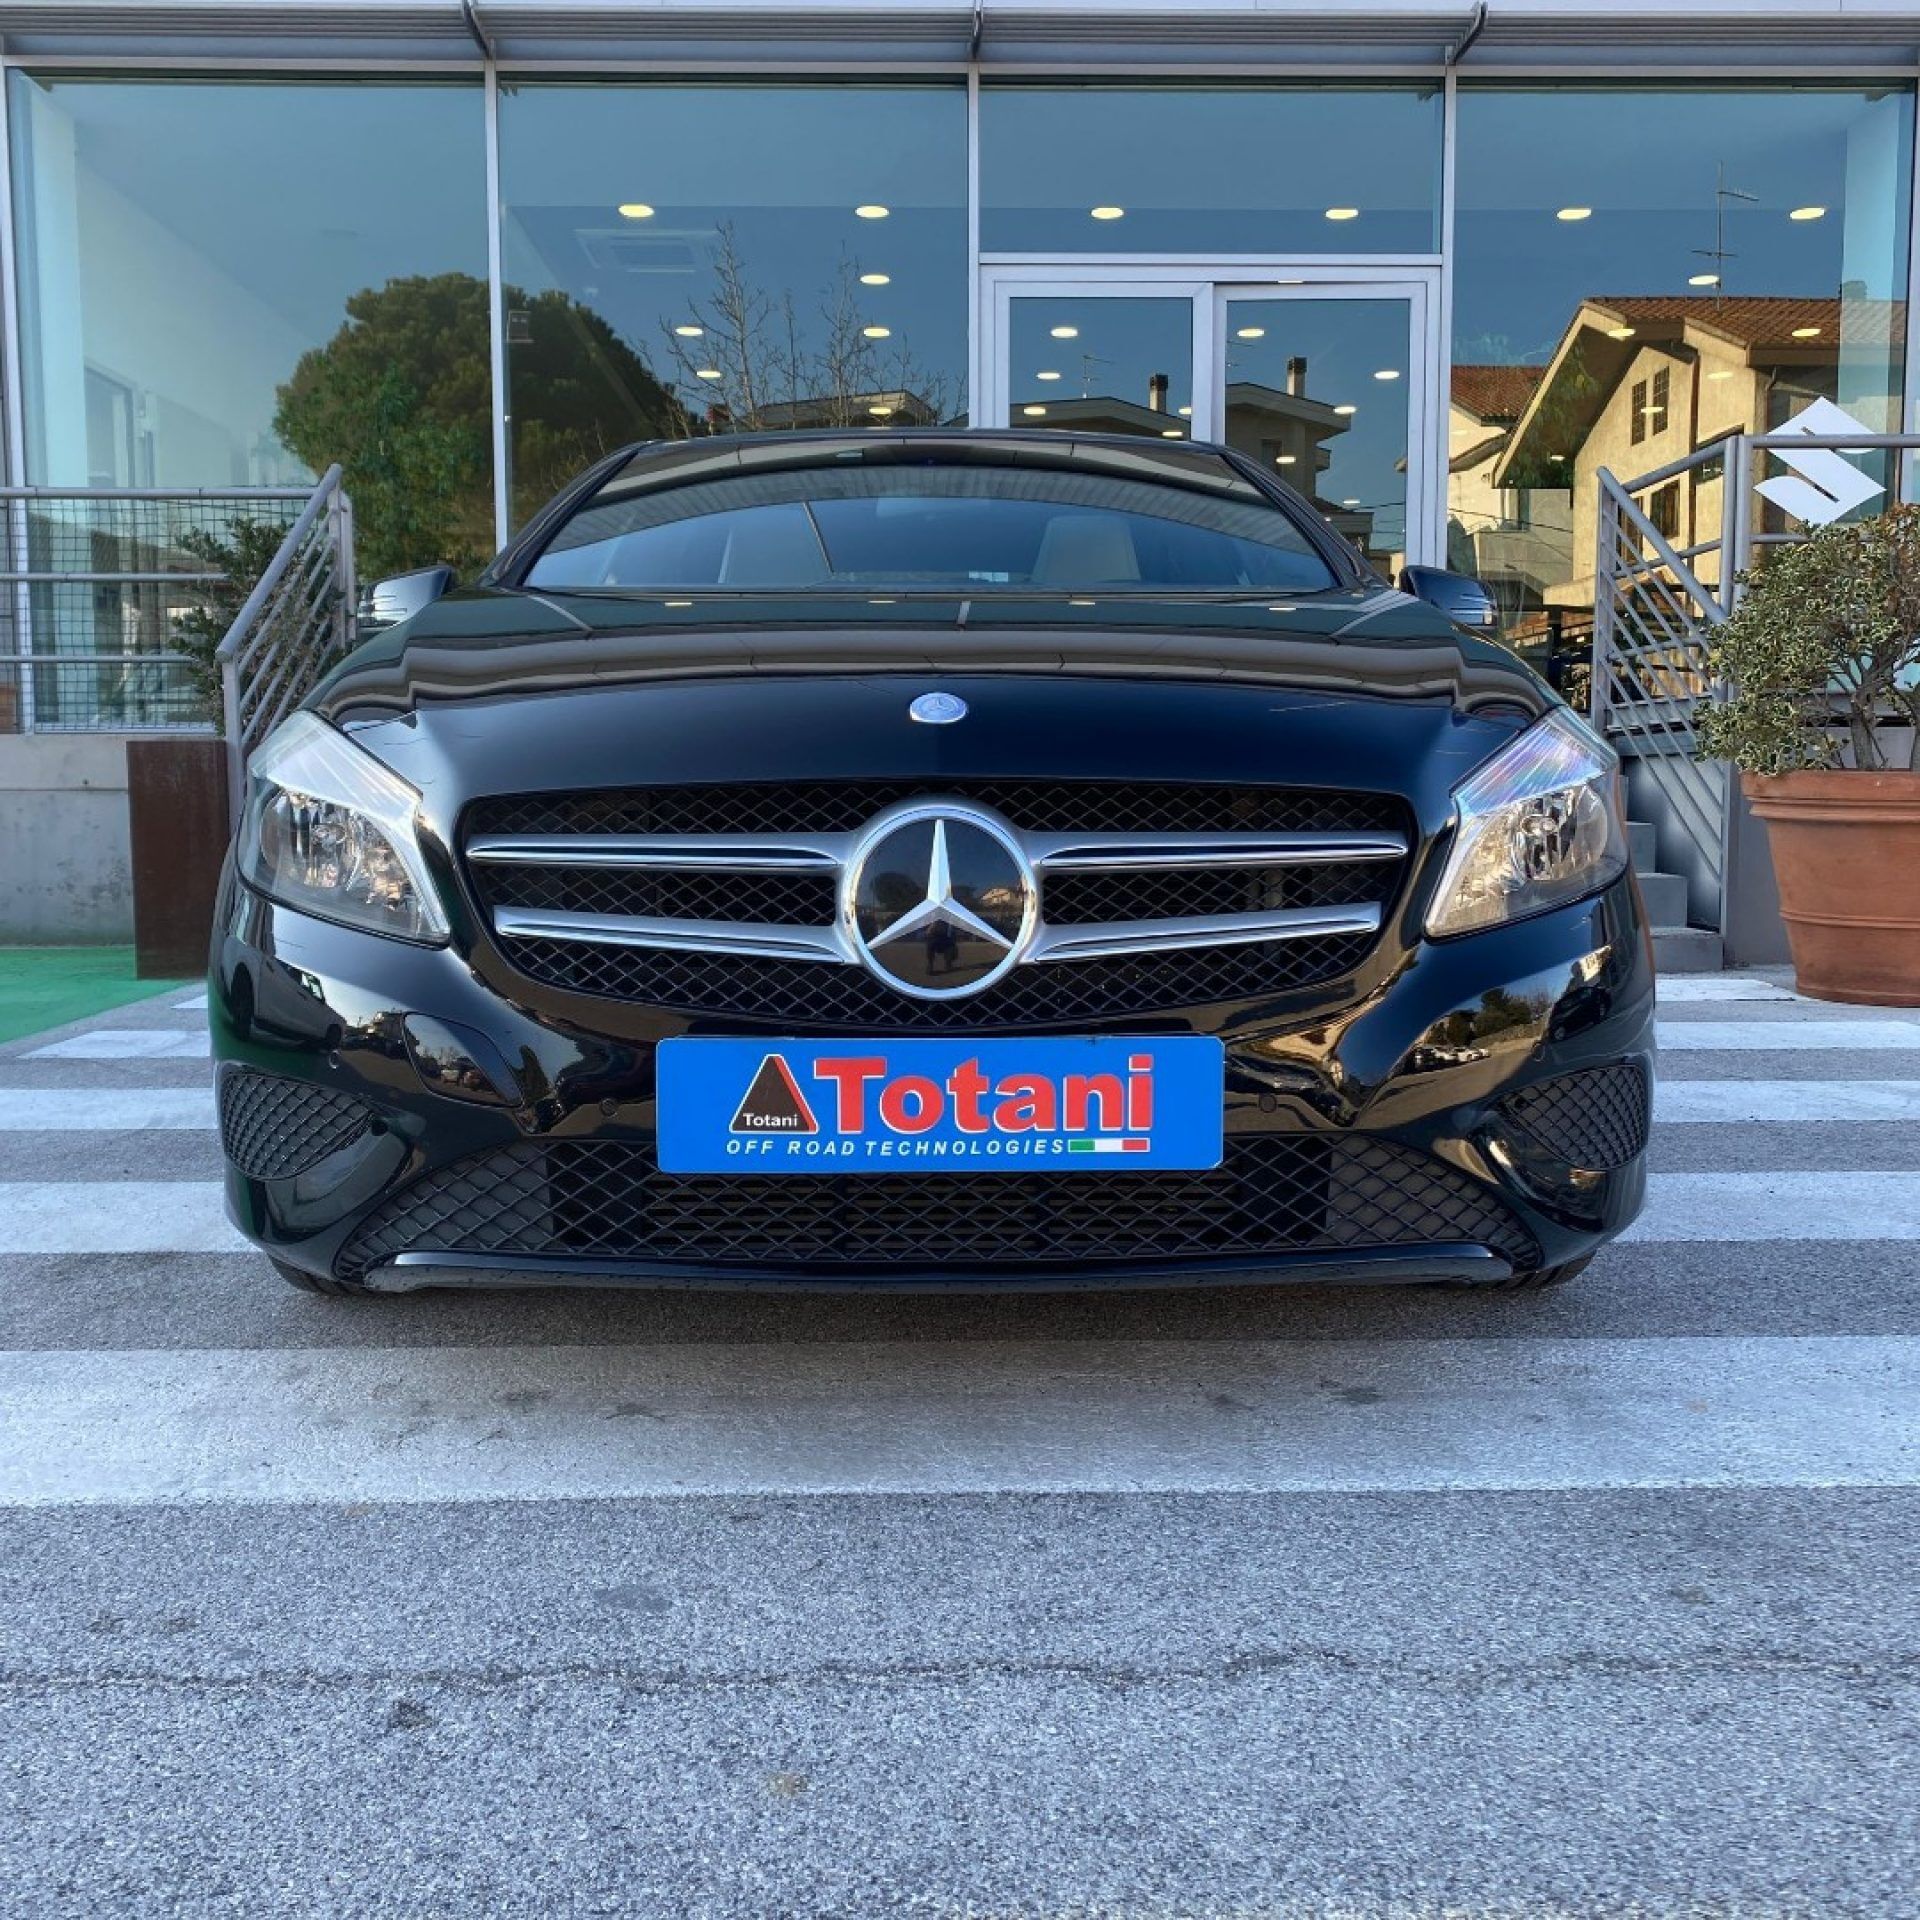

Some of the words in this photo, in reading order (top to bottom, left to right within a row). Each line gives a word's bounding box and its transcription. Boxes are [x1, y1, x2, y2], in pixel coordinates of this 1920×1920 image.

[813, 1054, 1154, 1134] Totani
[742, 1112, 798, 1128] Totani
[726, 1138, 774, 1155] OFF
[787, 1140, 855, 1156] ROAD
[865, 1138, 1065, 1156] TECHNOLOGIES
